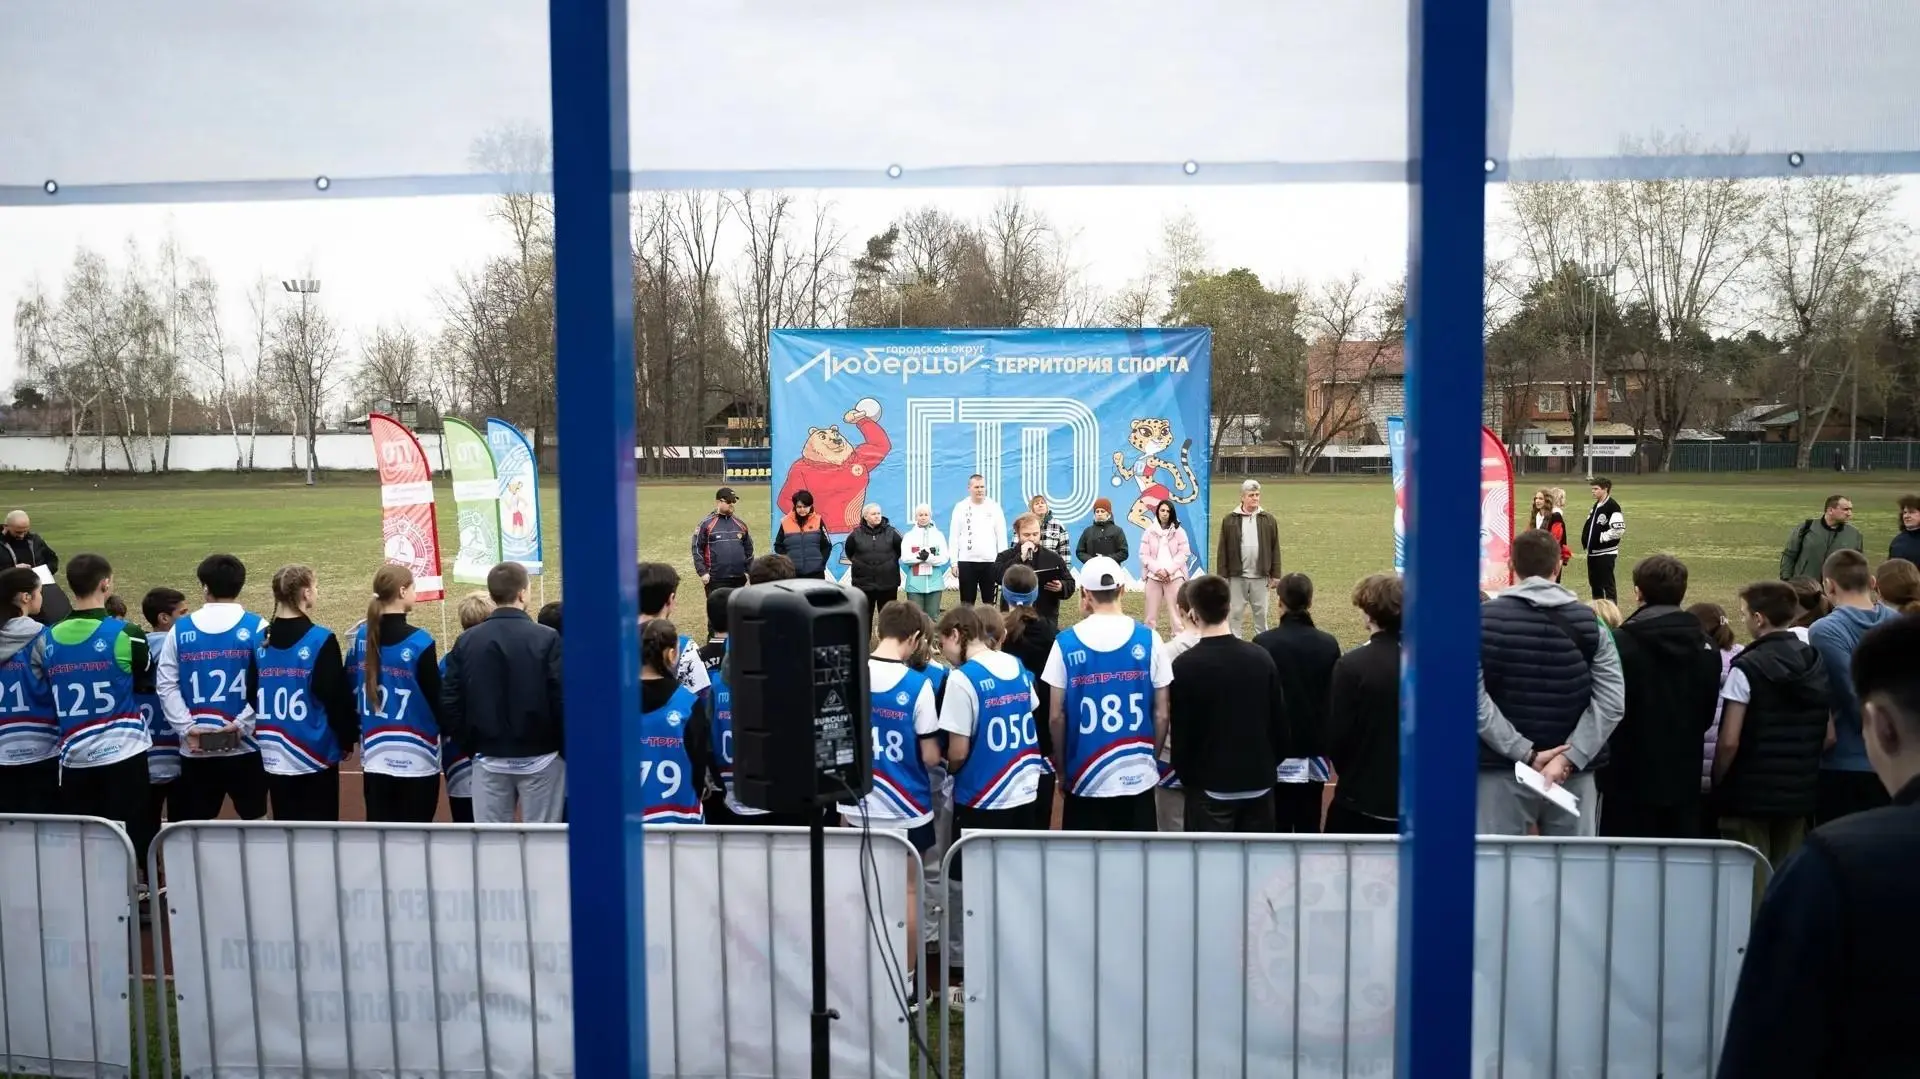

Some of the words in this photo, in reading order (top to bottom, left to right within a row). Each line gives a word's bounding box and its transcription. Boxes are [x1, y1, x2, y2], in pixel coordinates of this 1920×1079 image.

[785, 347, 985, 385] Люберцы
[995, 357, 1113, 374] ТЕРРИТОРИЯ
[1117, 356, 1190, 373] СПОРТА
[886, 344, 947, 356] городской
[951, 344, 985, 356] округ
[907, 398, 1099, 524] ГТО
[1067, 650, 1086, 666] ГТО
[52, 681, 116, 717] 125
[190, 669, 247, 704] 124
[979, 678, 995, 691] ГТО
[256, 686, 308, 721] 106
[814, 714, 851, 726] EUROLIV
[1080, 692, 1144, 735] 085
